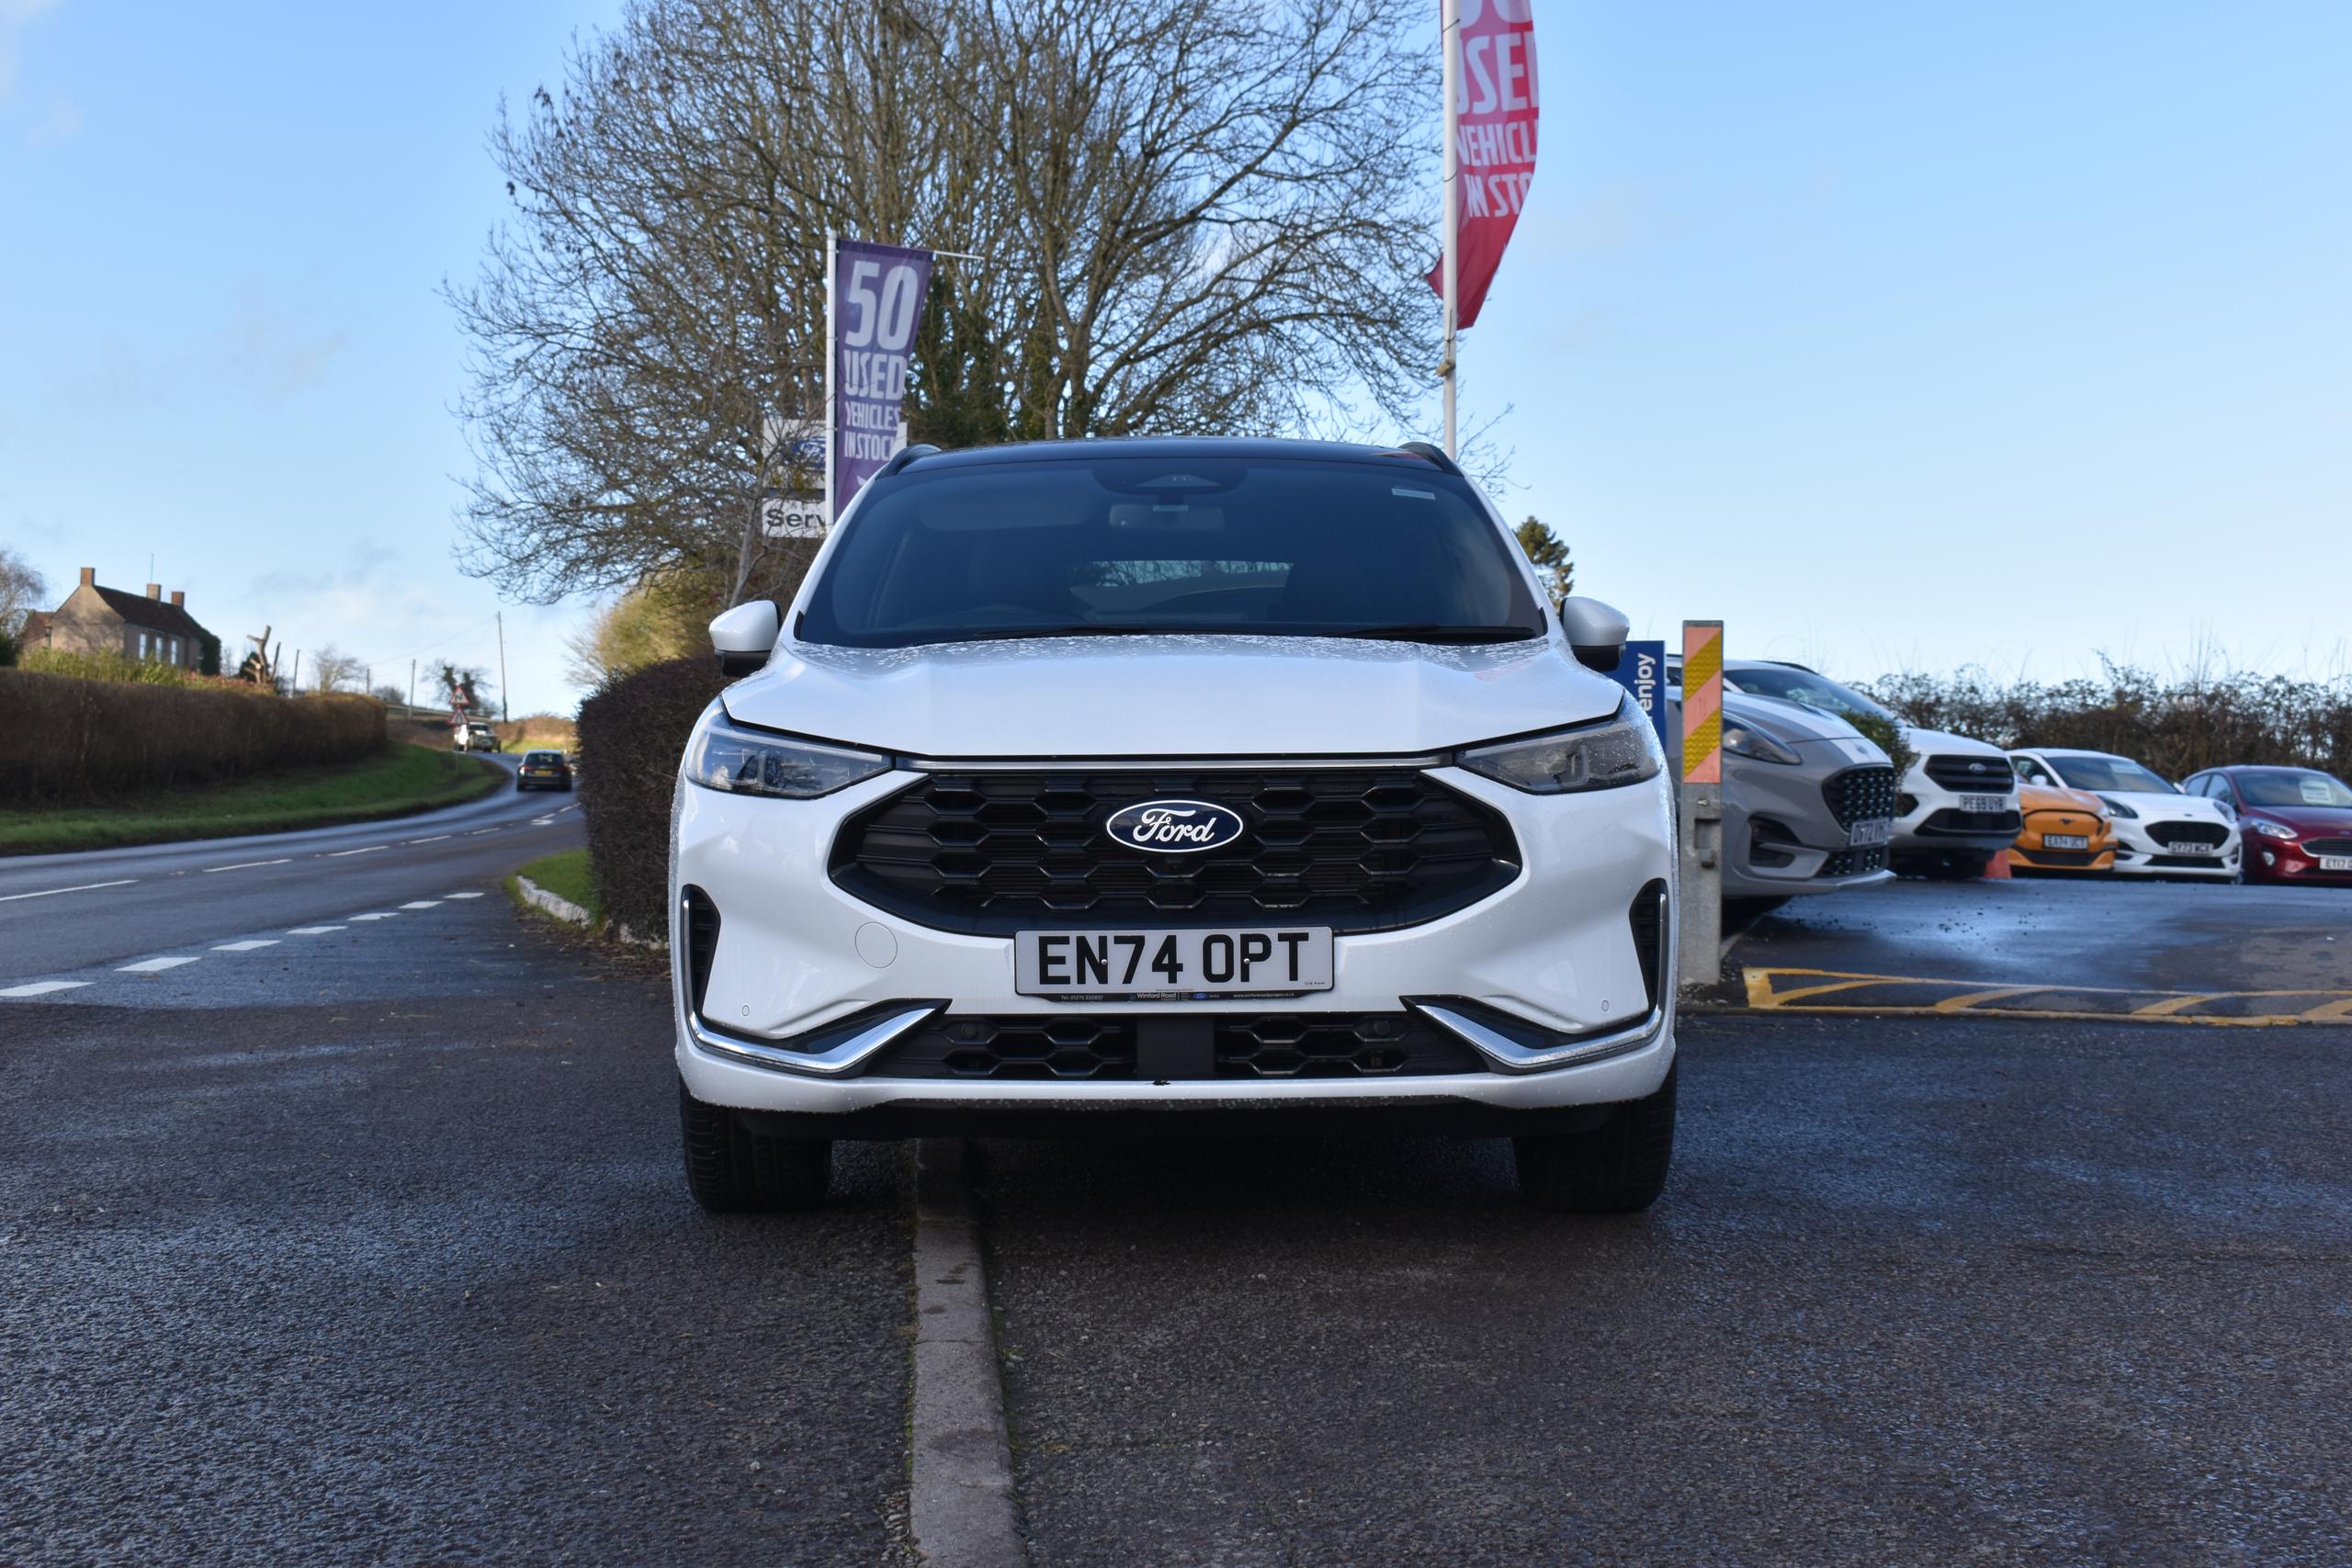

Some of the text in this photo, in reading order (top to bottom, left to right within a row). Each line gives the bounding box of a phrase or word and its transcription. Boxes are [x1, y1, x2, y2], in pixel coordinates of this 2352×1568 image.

[1456, 119, 1539, 166] VEHICL
[1464, 173, 1489, 218] IN
[844, 260, 918, 351] 50
[843, 350, 908, 400] USED
[845, 400, 901, 432] VEHICLES
[1634, 652, 1657, 712] enjoy
[1132, 807, 1217, 842] Ford
[1038, 931, 1309, 986] EN74 OPT
